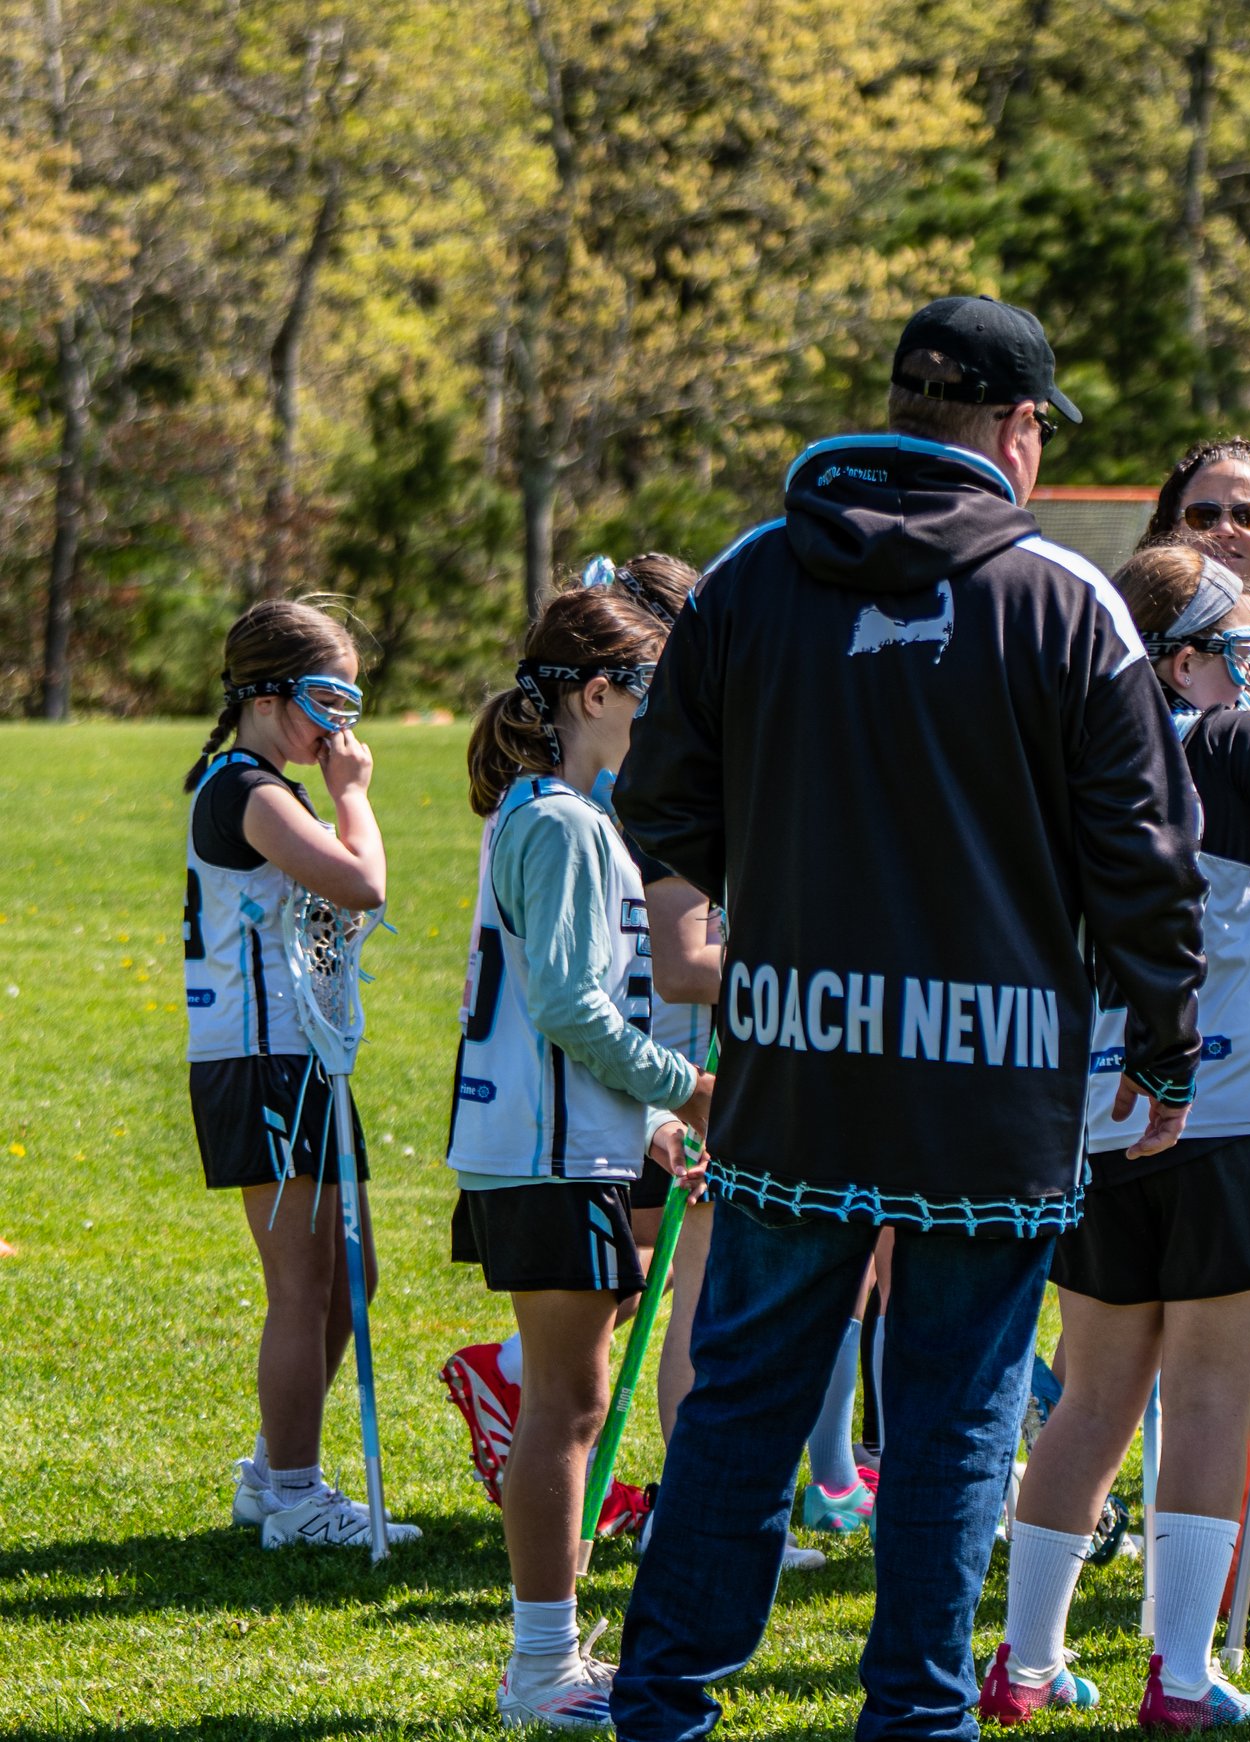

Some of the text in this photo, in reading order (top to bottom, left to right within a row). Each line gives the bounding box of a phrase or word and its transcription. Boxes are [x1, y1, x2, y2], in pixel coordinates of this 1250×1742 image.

[616, 568, 647, 597] STX
[538, 666, 581, 681] STX
[237, 684, 258, 699] STX
[518, 674, 550, 713] STX
[542, 723, 562, 768] STX
[728, 961, 885, 1055] COACH
[899, 976, 1059, 1069] NEVIN
[460, 1085, 477, 1096] rine
